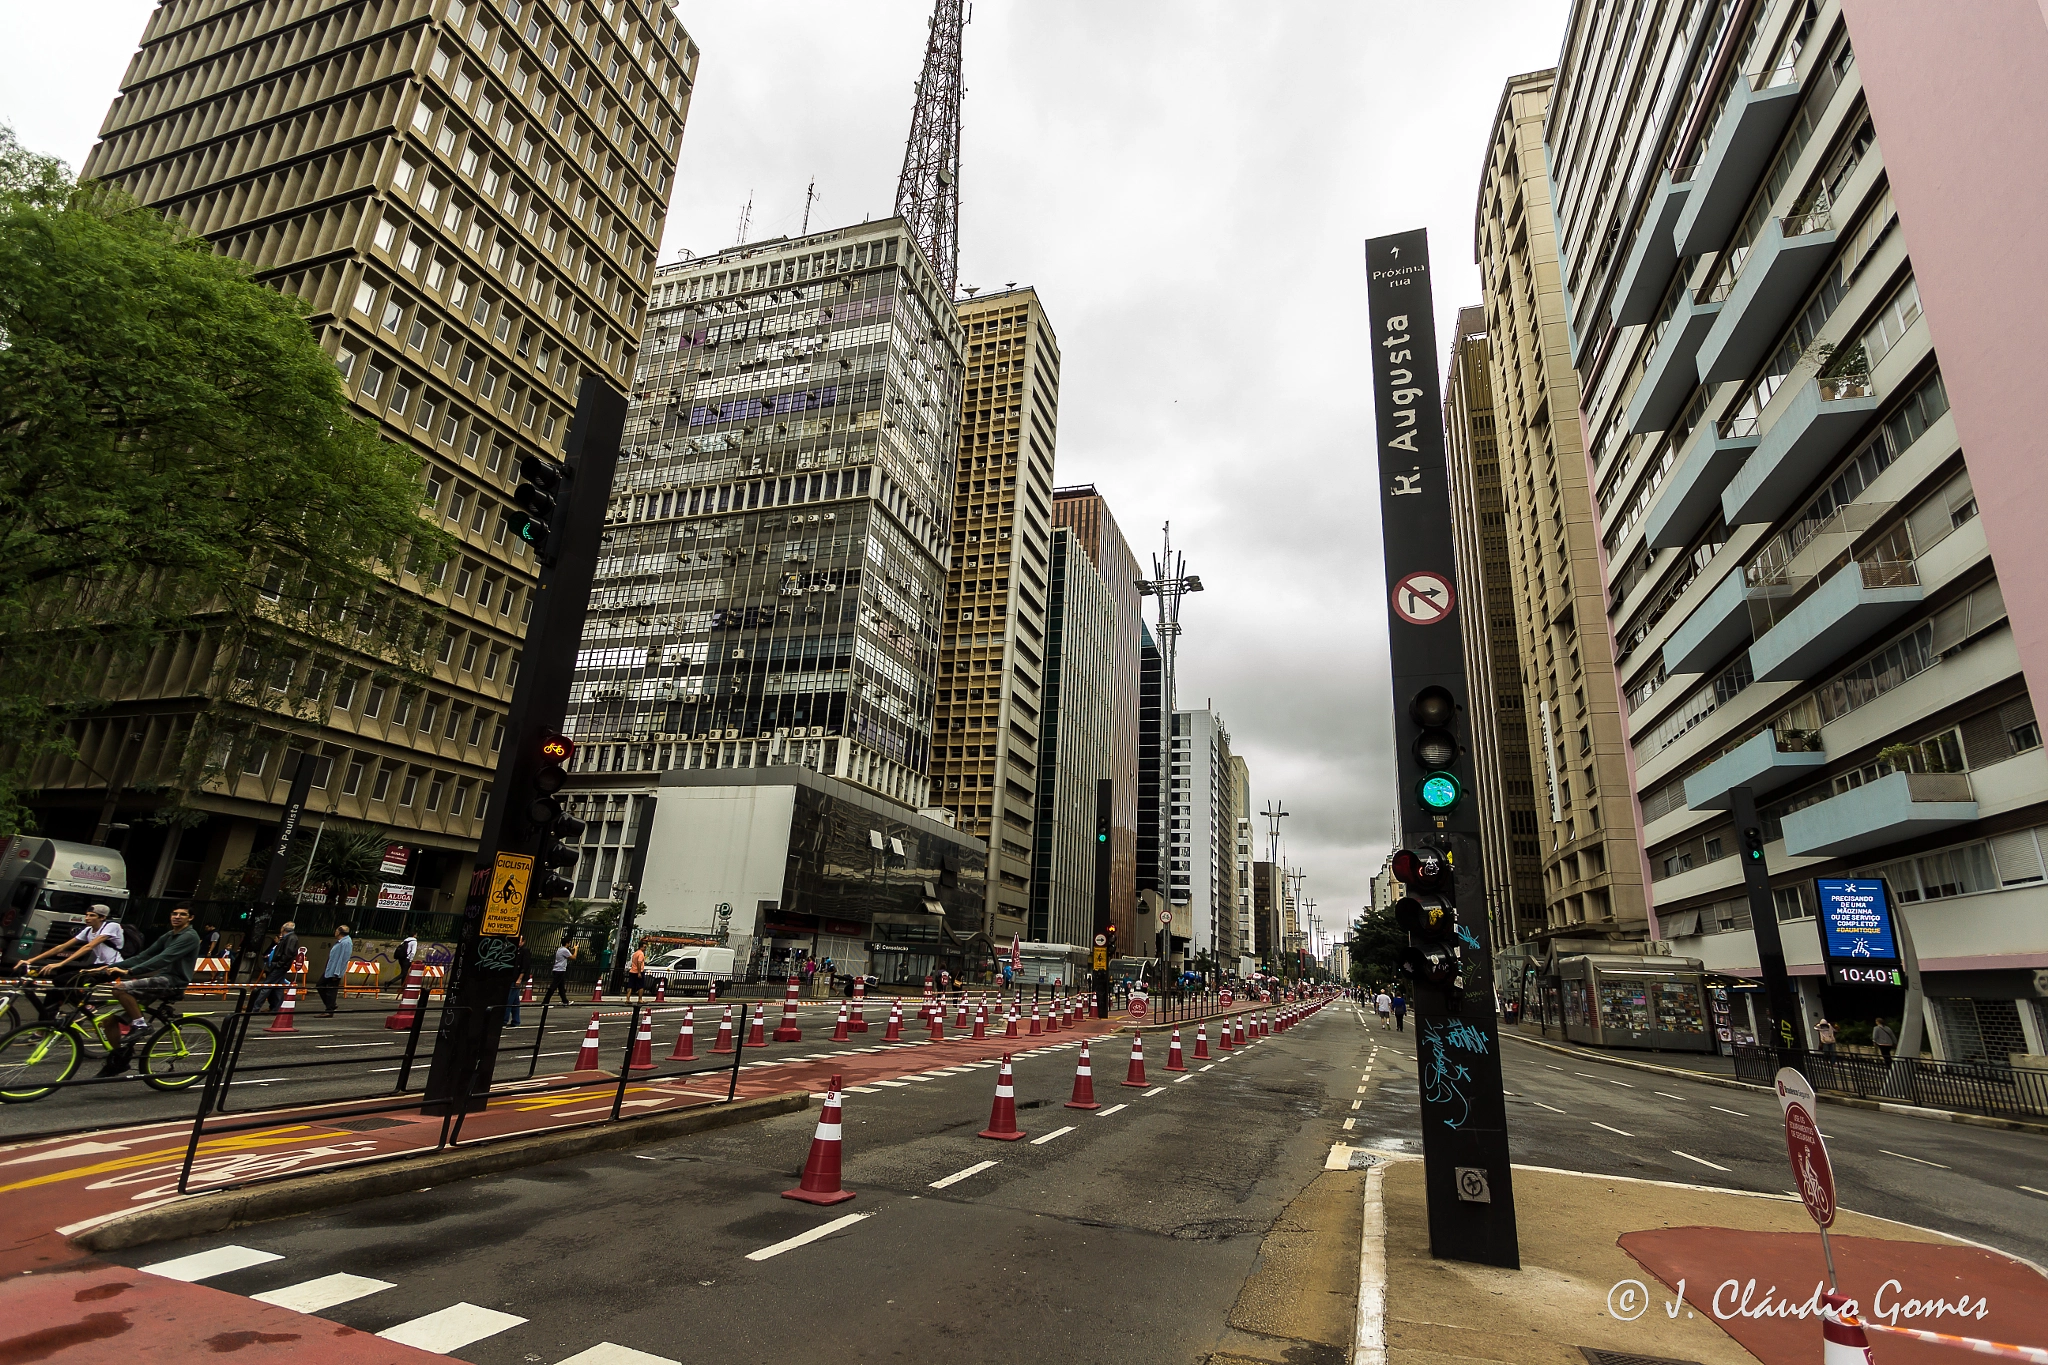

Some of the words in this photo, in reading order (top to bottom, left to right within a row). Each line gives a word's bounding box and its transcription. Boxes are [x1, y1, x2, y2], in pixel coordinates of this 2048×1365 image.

[1373, 264, 1425, 280] Próxima
[1390, 278, 1411, 288] rua
[1383, 314, 1424, 452] Augusta
[1391, 465, 1422, 496] R.
[281, 803, 300, 841] Paulista
[277, 843, 288, 857] Av.
[497, 859, 530, 871] CICLISTA
[387, 893, 411, 901] ALUGA
[720, 904, 730, 915] P
[487, 915, 517, 923] ATRAVESSE
[1839, 968, 1887, 982] 10:40
